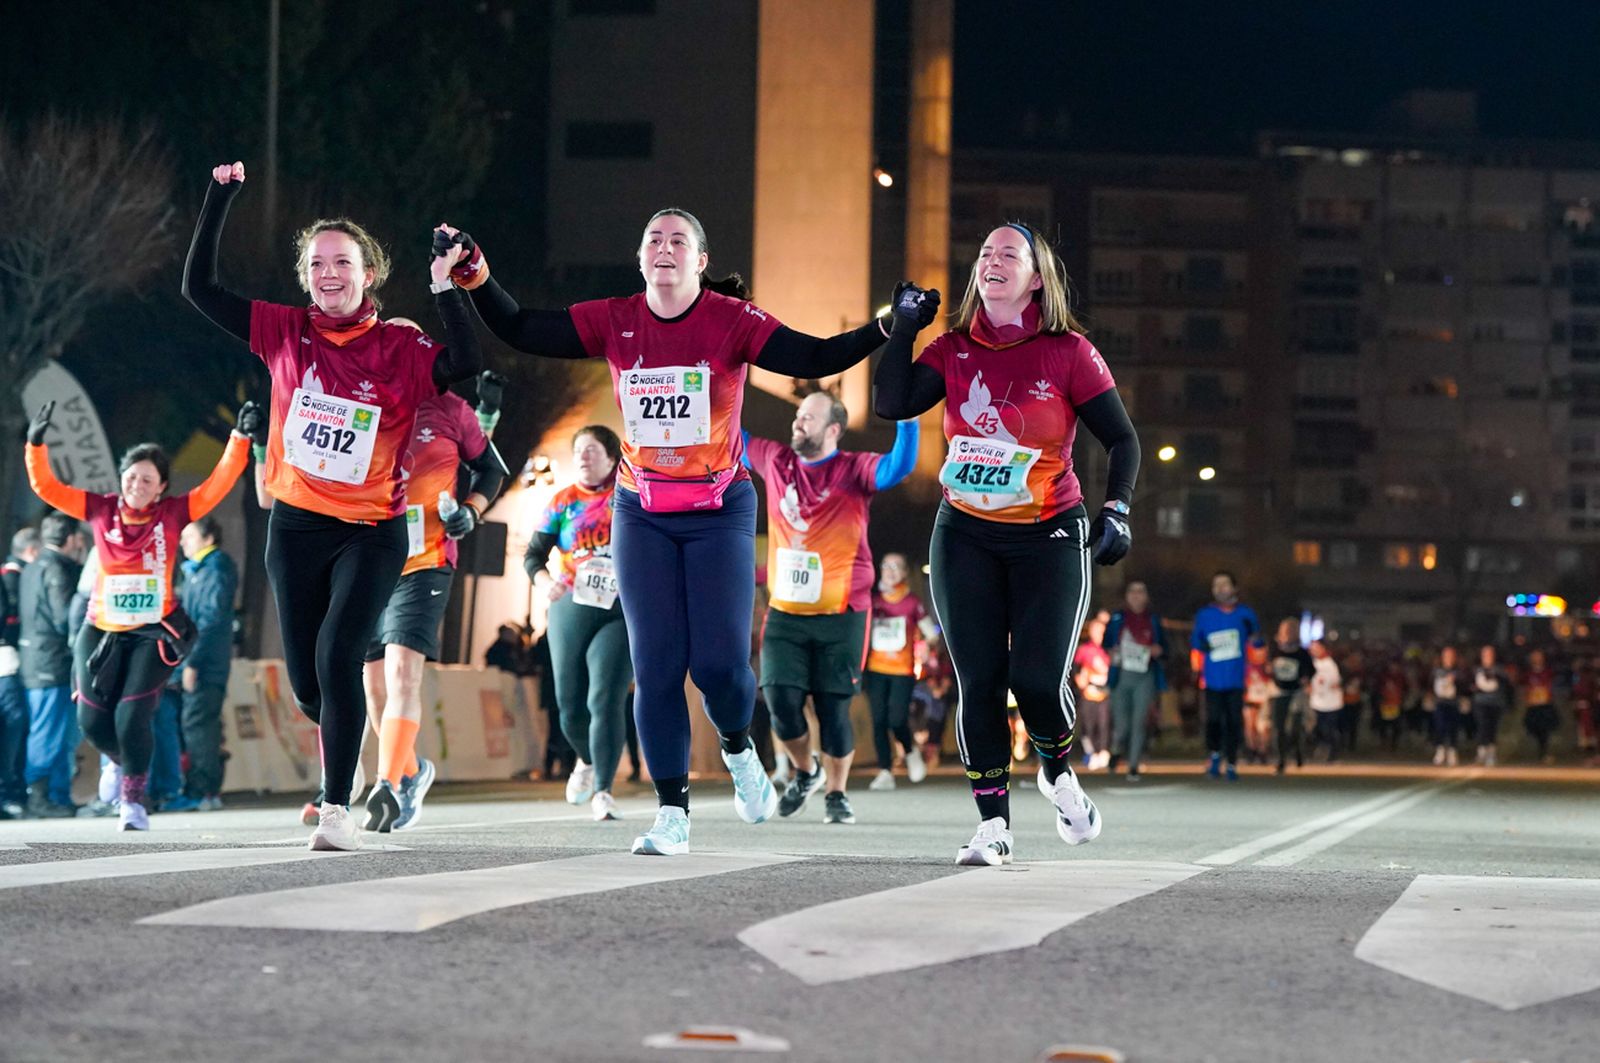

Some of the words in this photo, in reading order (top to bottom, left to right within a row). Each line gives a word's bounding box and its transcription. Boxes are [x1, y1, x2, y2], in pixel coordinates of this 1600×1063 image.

[639, 376, 665, 385] NOCHE
[666, 376, 676, 384] DE
[629, 387, 646, 396] SAN
[311, 402, 336, 414] NOCHE
[336, 408, 348, 416] DE
[639, 395, 691, 419] 2212
[298, 409, 316, 420] SAN
[974, 411, 999, 435] 43
[301, 422, 356, 454] 4512
[657, 448, 675, 456] SAN
[994, 450, 1006, 458] DE
[955, 463, 1013, 486] 4325
[693, 500, 711, 508] SPORT
[113, 594, 154, 608] 12372
